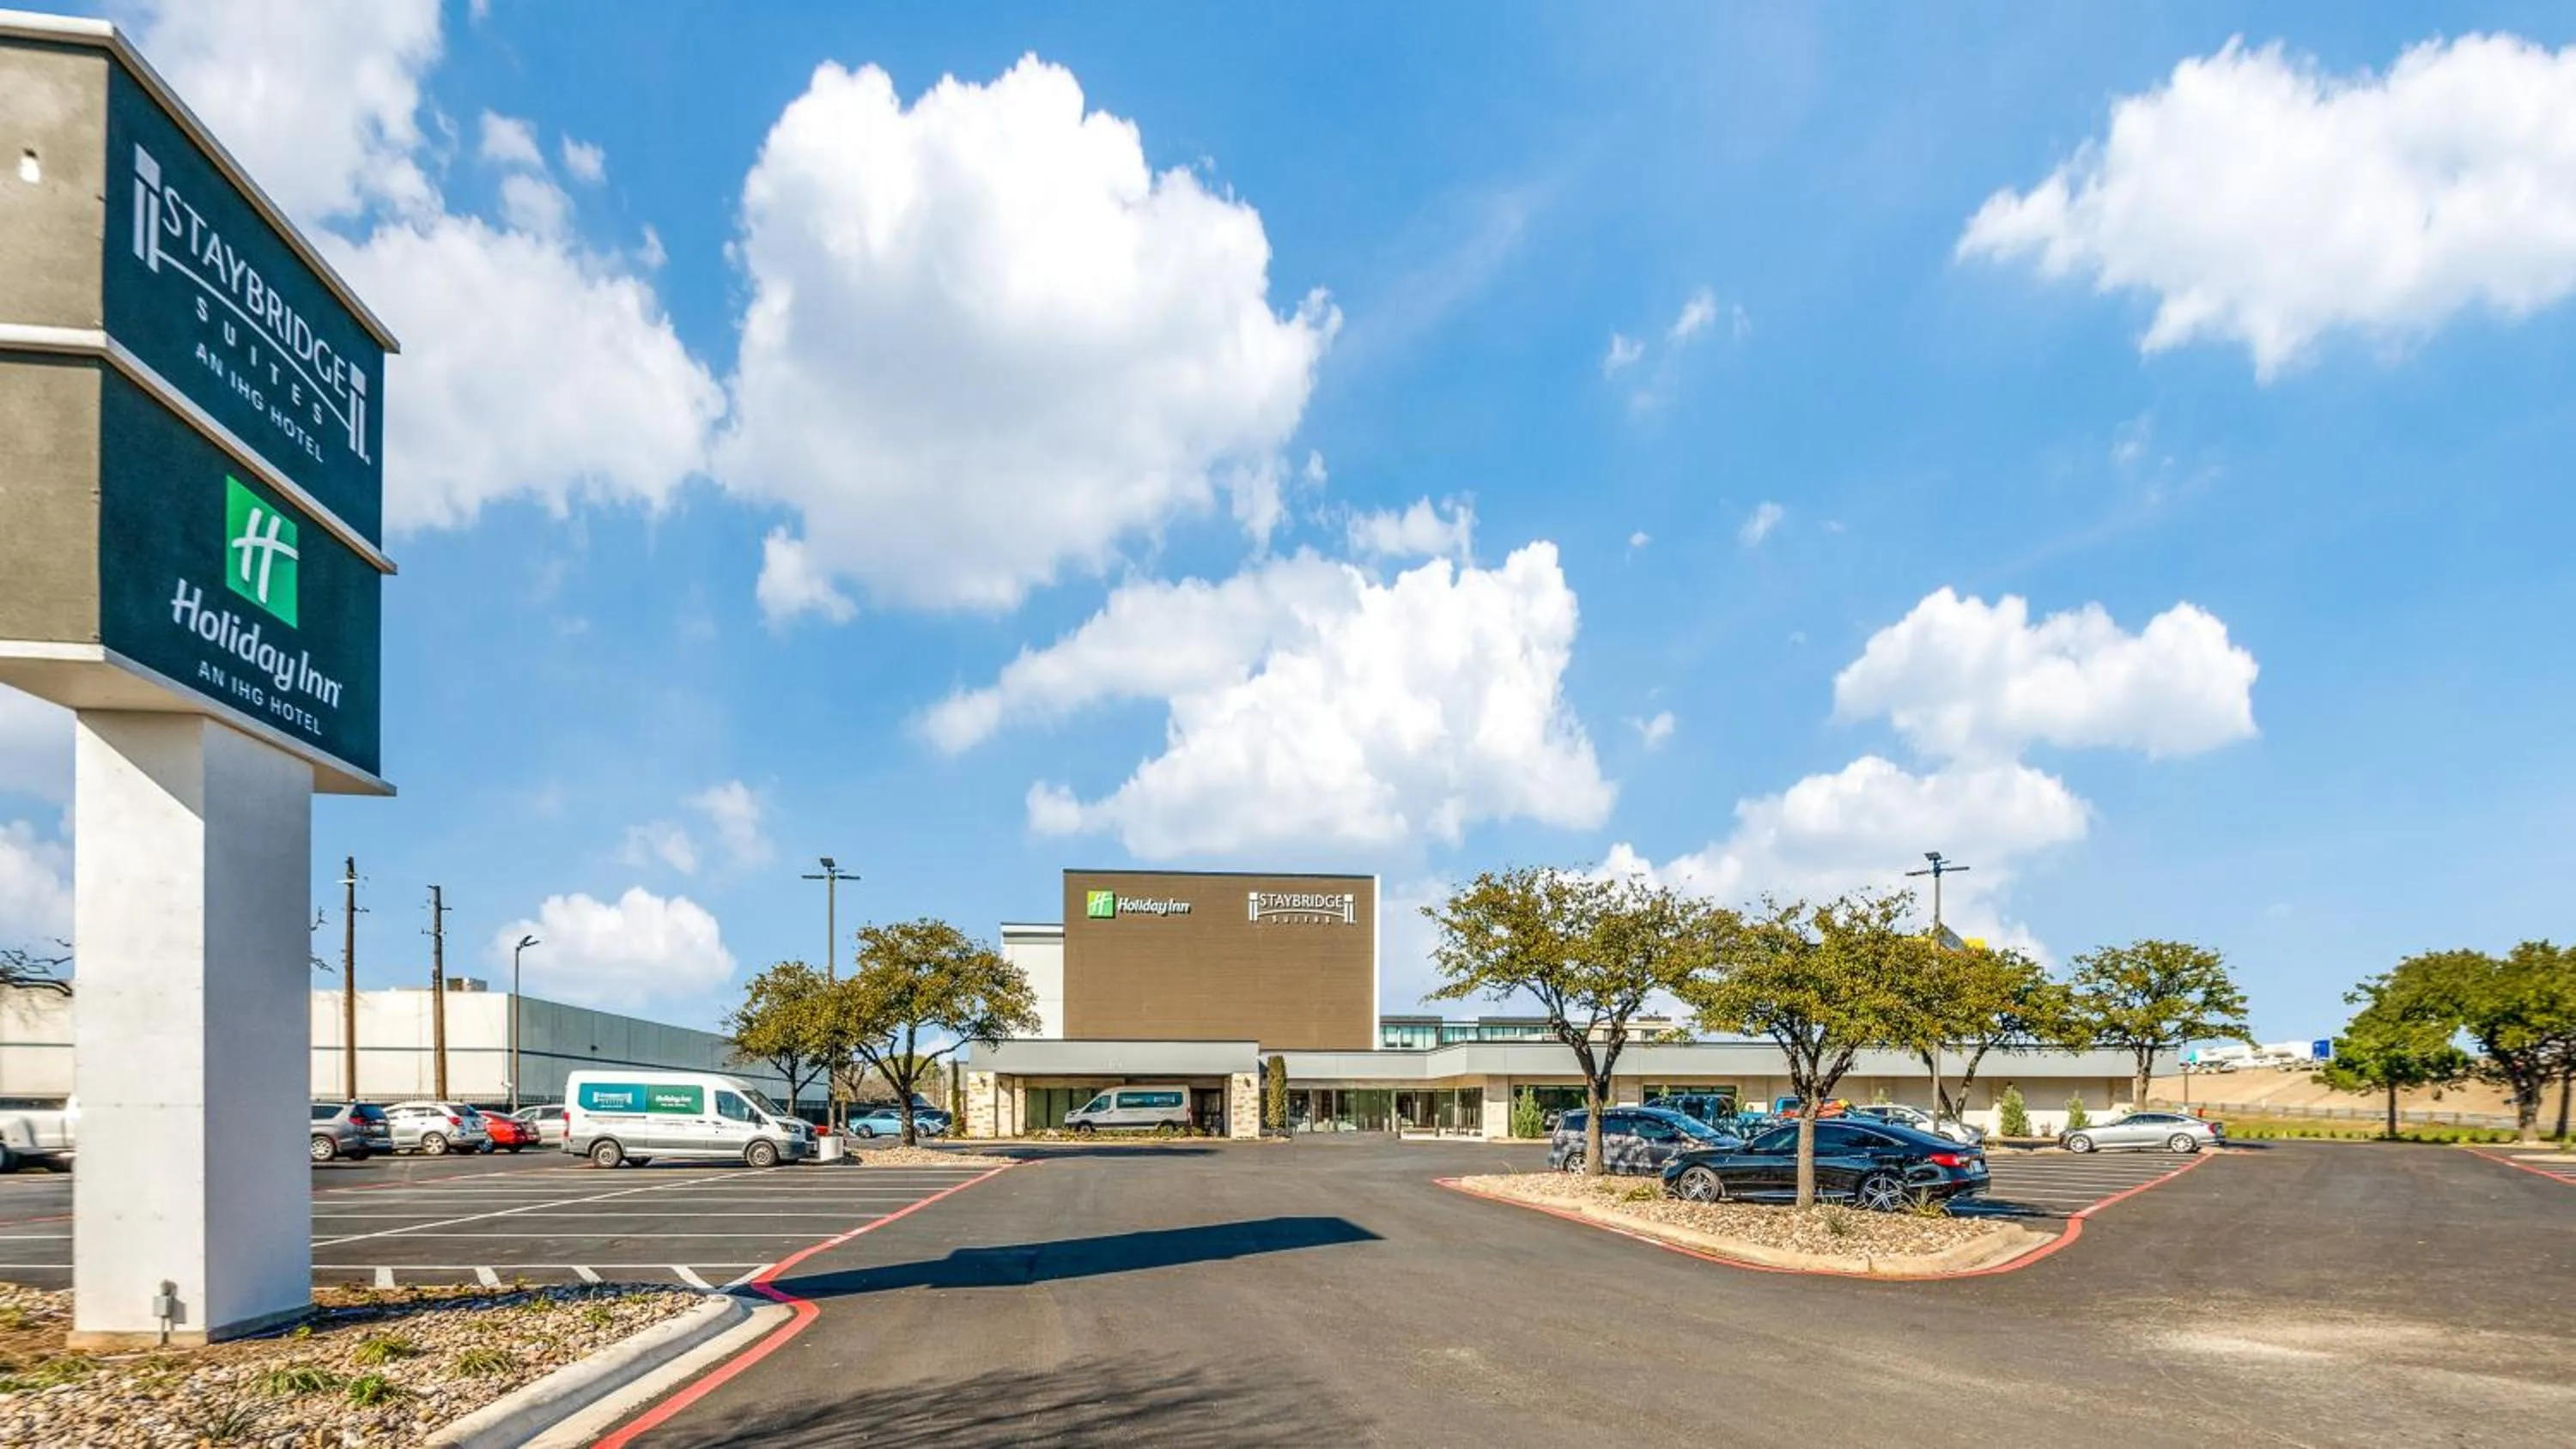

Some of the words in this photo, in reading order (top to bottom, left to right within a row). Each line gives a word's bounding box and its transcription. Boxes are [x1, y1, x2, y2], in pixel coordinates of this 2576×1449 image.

[161, 185, 347, 398] STAYBRIDGE
[195, 295, 323, 425] SUITES
[195, 342, 224, 379] AN
[229, 369, 265, 412] IHG
[270, 404, 324, 464] HOTEL
[171, 576, 295, 693] Holiday
[298, 649, 340, 710] Inn
[197, 659, 226, 688] AN
[231, 676, 264, 707] IHG
[270, 695, 323, 737] HOTEL
[1117, 896, 1168, 916] Holiday
[1167, 897, 1191, 914] Inn
[1259, 893, 1344, 908] STAYBRIDGE
